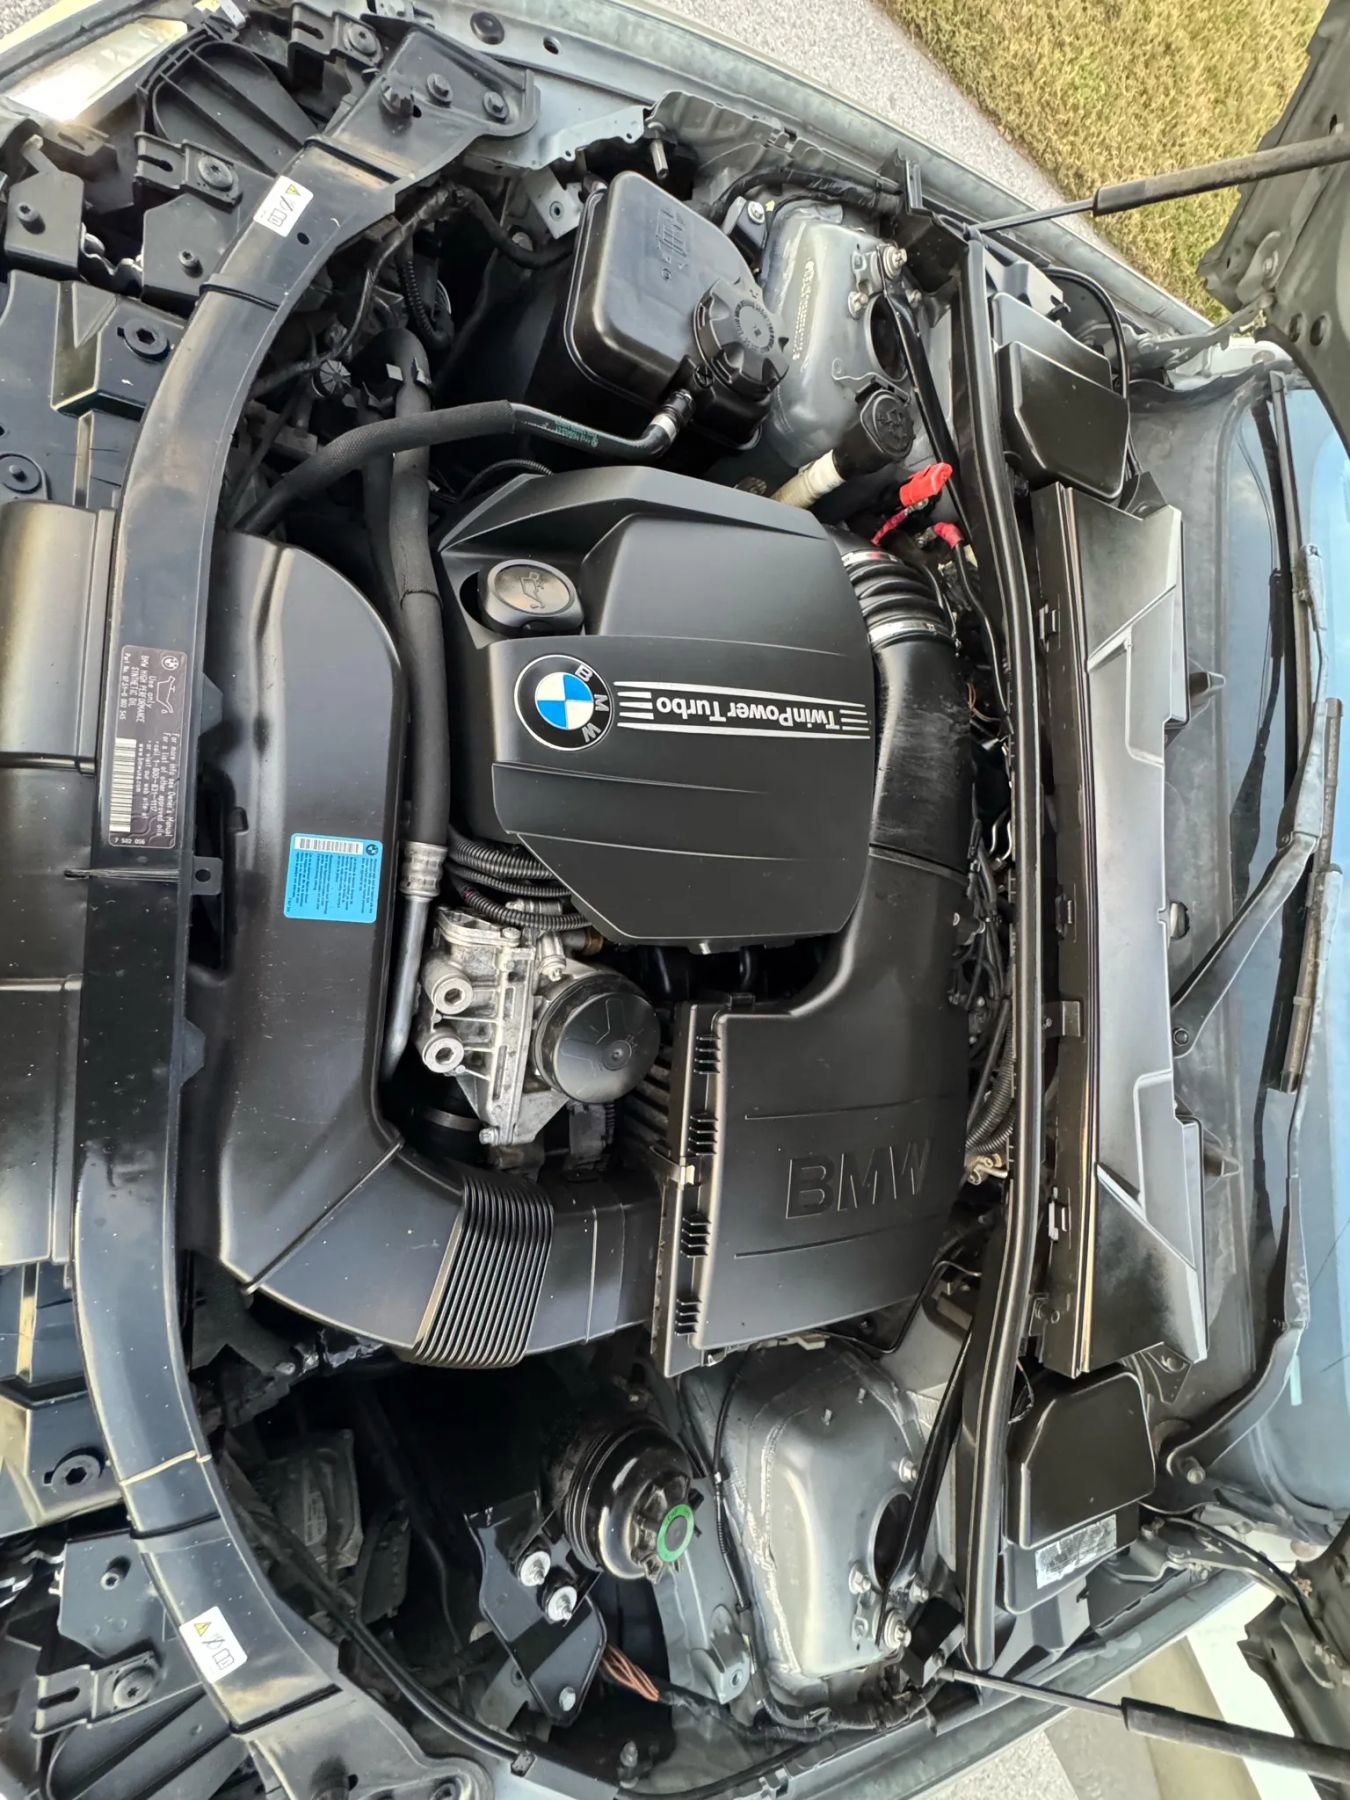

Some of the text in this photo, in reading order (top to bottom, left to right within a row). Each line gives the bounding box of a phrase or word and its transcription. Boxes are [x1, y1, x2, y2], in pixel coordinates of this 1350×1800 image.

[140, 655, 150, 668] BMW
[128, 666, 139, 708] SYNTHETIC OIL
[146, 675, 157, 708] Use only
[136, 685, 147, 722] PERFORMANCE
[656, 697, 840, 730] TwinPower Turbo
[161, 752, 170, 763] list
[169, 763, 177, 775] info
[159, 776, 168, 792] other
[157, 795, 165, 821] approved
[165, 816, 174, 837] Manual
[785, 1138, 932, 1220] BMW
